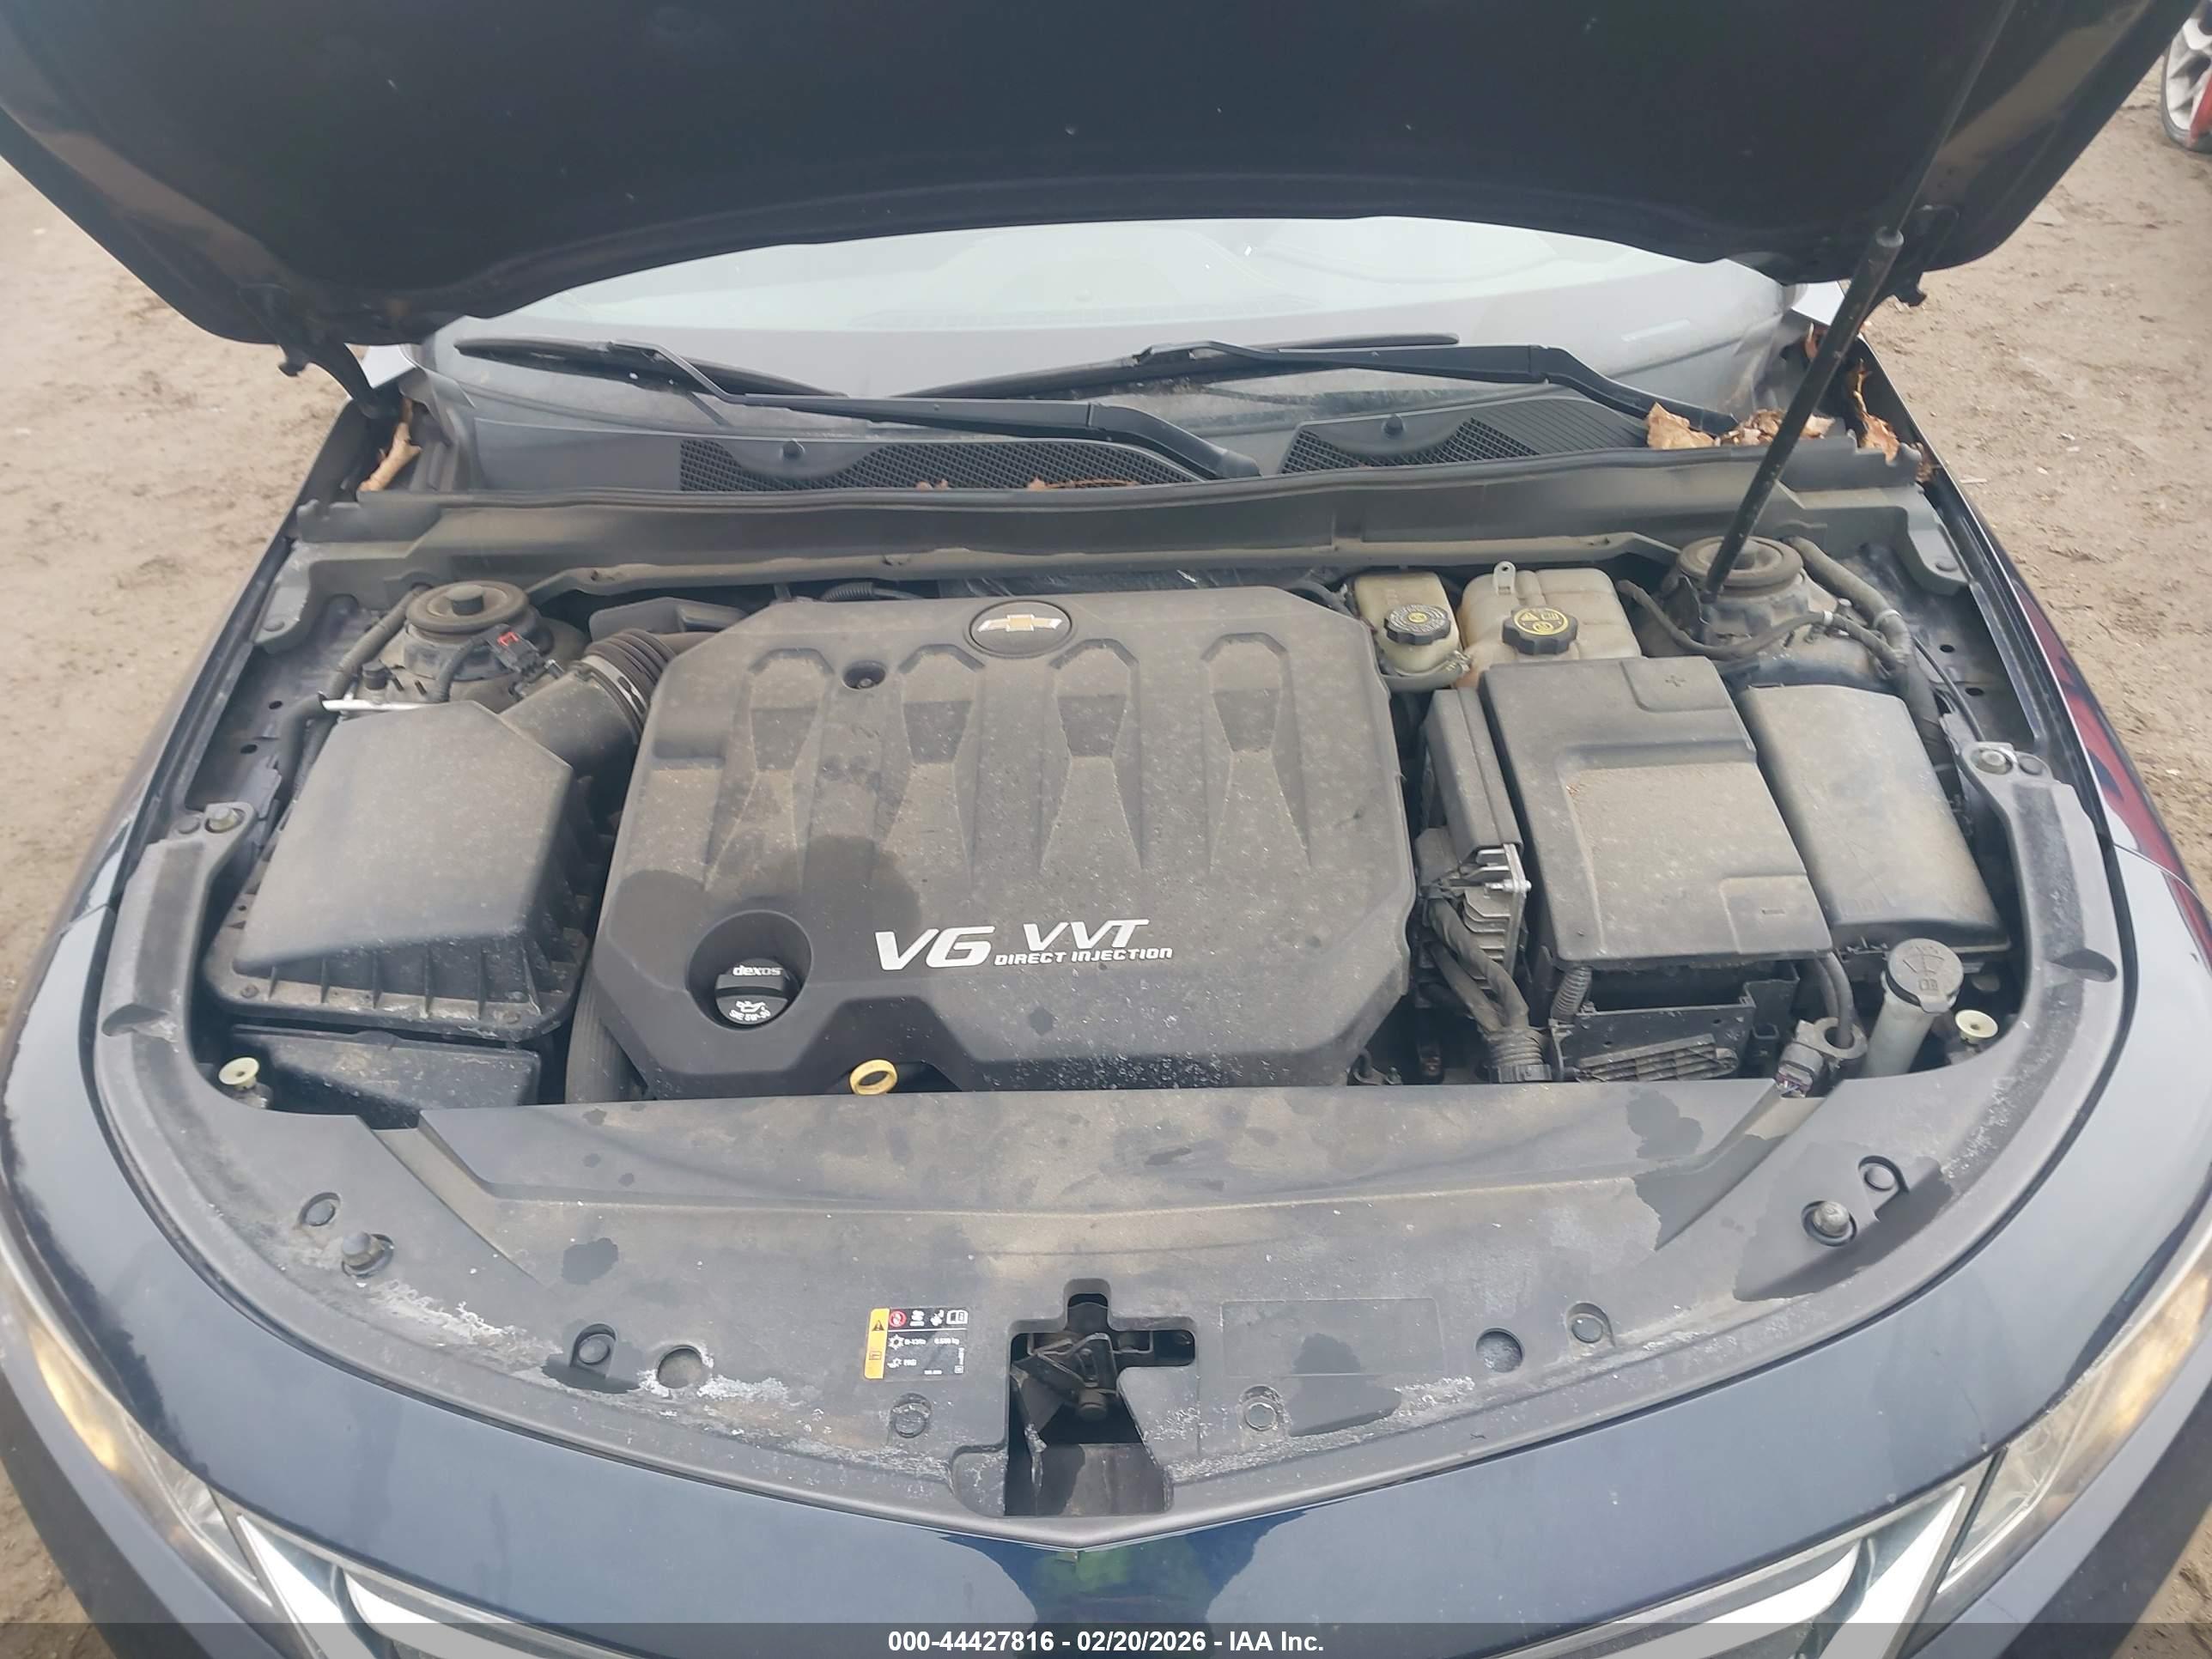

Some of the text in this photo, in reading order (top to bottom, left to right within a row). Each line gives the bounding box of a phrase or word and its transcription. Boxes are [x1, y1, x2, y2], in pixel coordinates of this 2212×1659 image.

[874, 925, 996, 971] V6
[1023, 918, 1151, 952] VVT
[732, 964, 784, 976] dexos
[994, 946, 1174, 967] DIRECT INJECTION
